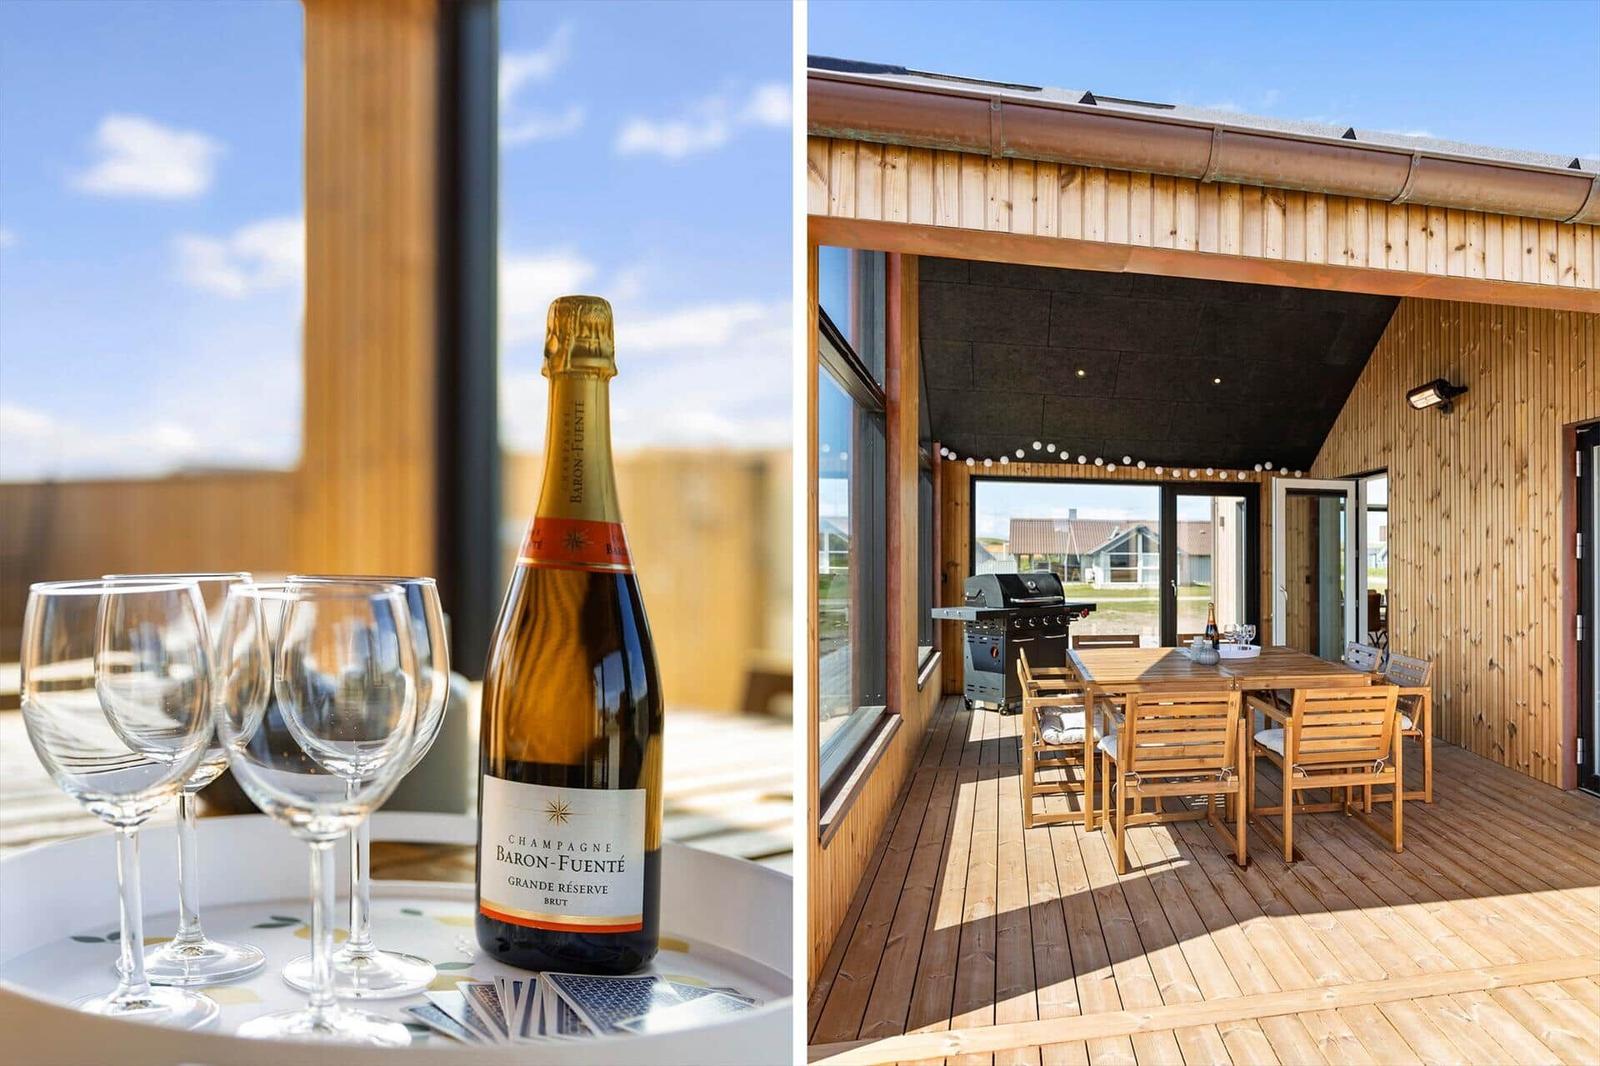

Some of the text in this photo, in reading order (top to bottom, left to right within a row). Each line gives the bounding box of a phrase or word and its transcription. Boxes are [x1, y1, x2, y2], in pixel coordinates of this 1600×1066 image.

[508, 834, 613, 853] CHAMPAGNE
[496, 844, 625, 873] BARON-FUENTÉ
[508, 876, 609, 895] GRANDE RÉSERVE
[544, 897, 568, 906] BRUT
